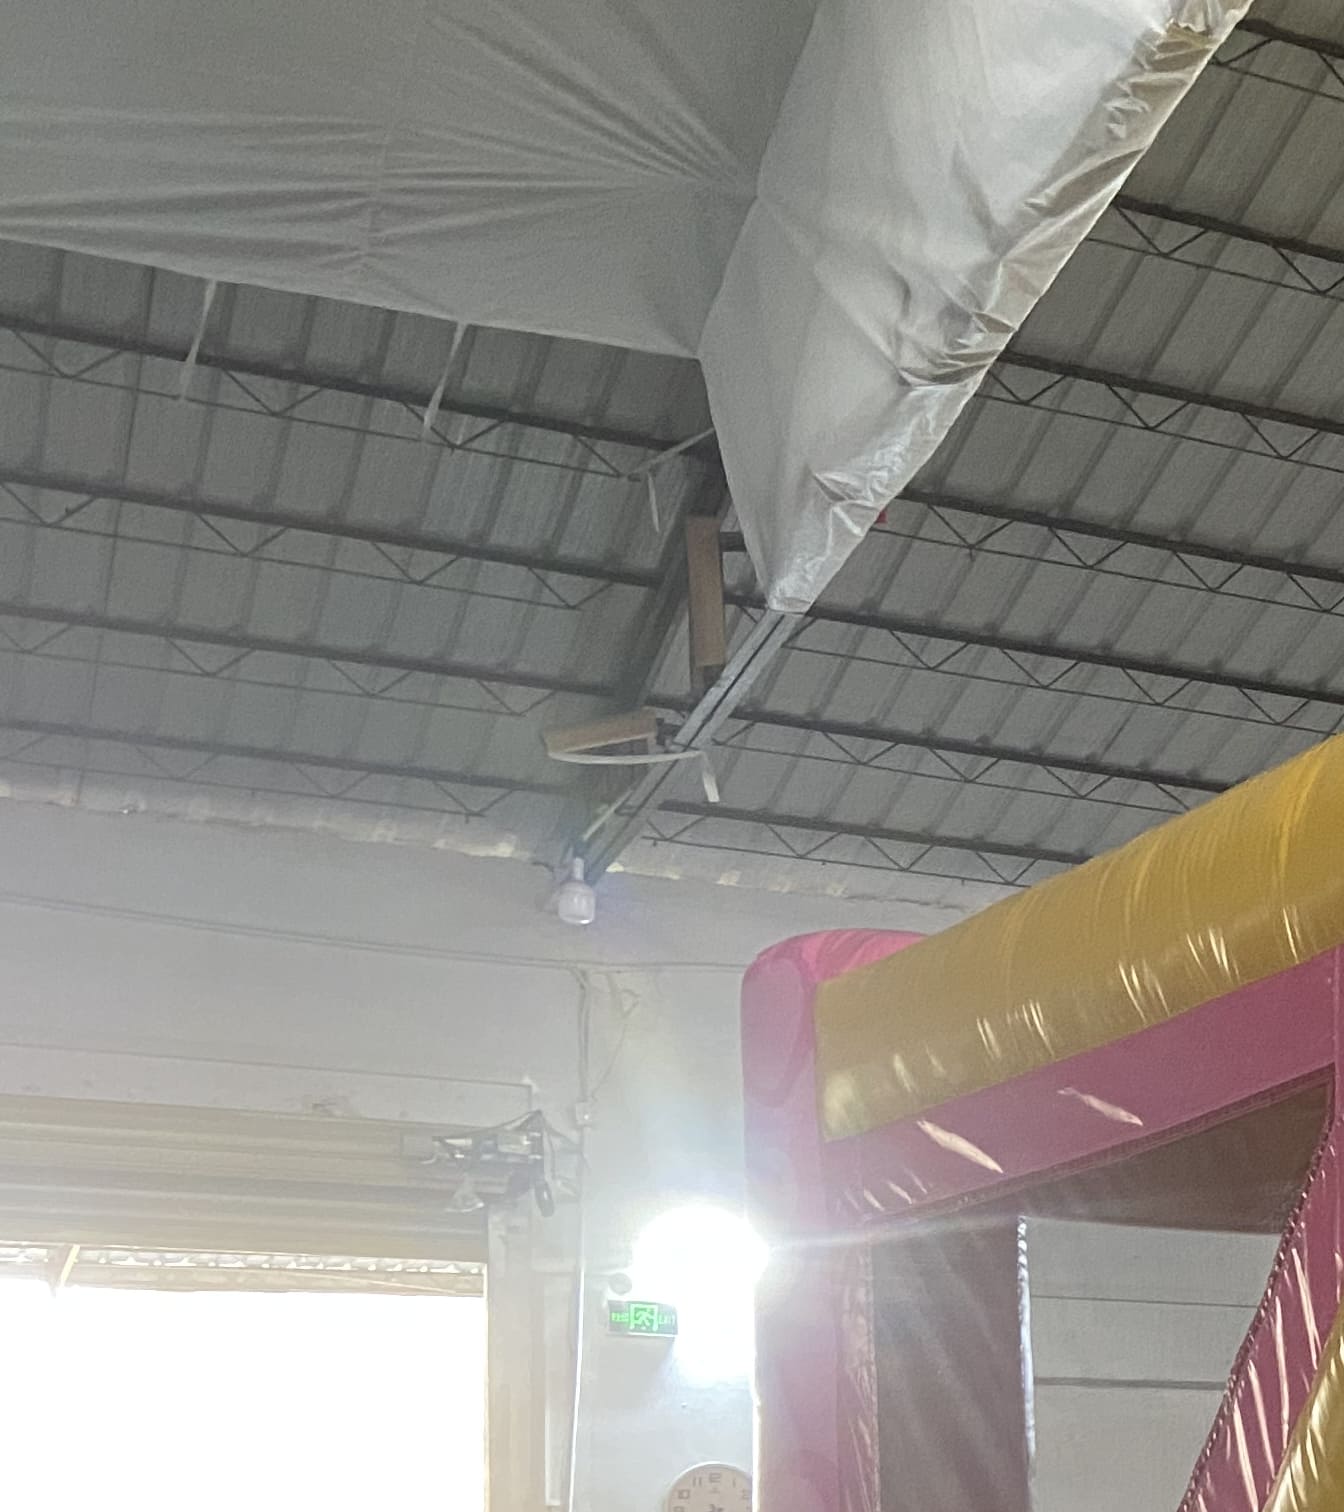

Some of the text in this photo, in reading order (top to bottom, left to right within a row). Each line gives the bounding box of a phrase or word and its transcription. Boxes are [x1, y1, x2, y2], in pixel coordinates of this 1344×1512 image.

[692, 1477, 702, 1488] 11
[708, 1472, 721, 1484] 12
[677, 1489, 690, 1500] 10
